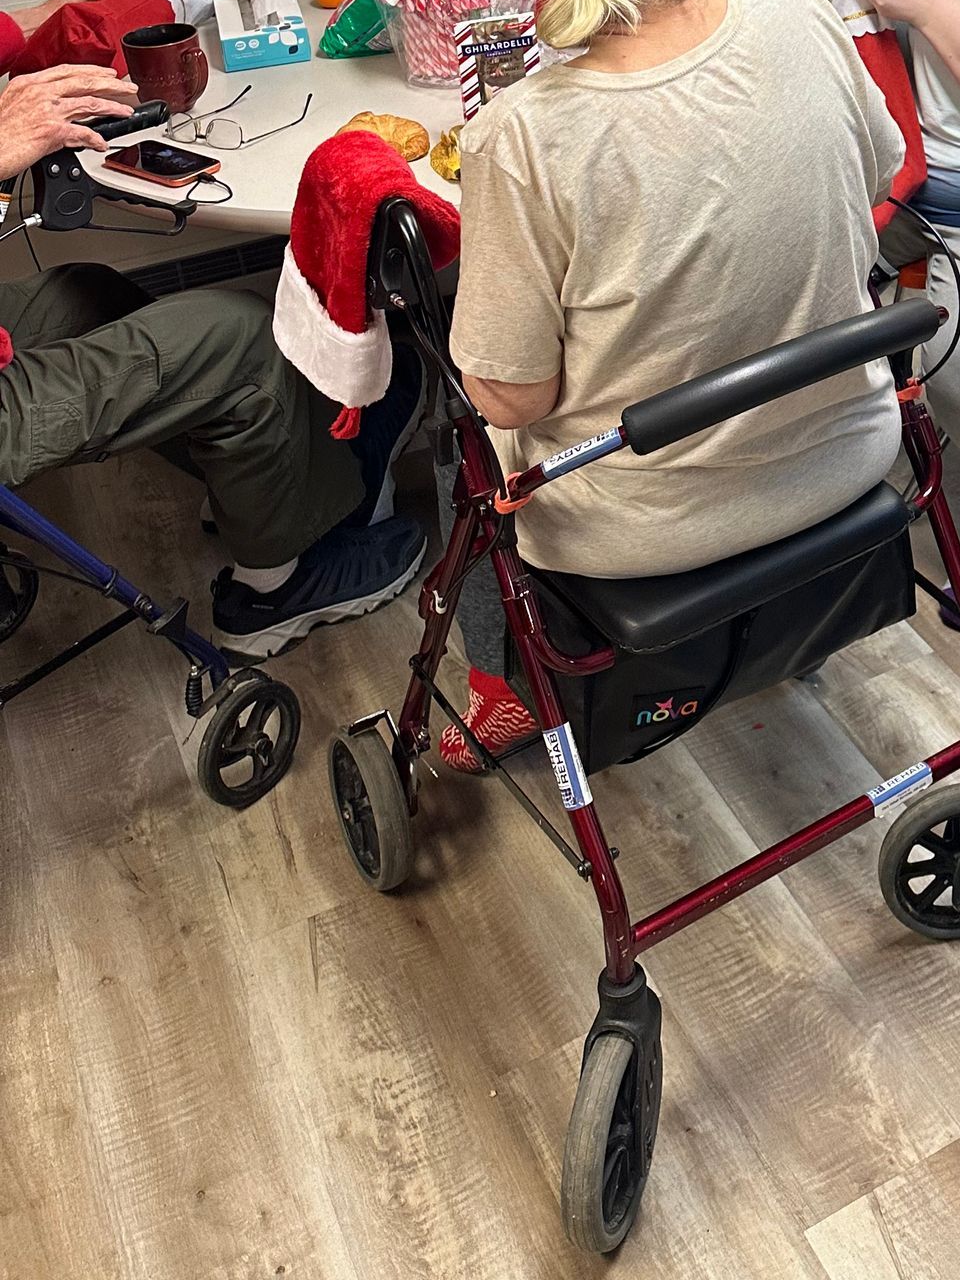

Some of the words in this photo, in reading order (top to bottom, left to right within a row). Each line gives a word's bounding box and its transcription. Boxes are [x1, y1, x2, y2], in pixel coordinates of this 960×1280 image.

[465, 38, 531, 54] GHIRARDELLI
[636, 699, 699, 726] nova
[549, 732, 569, 784] REHAB
